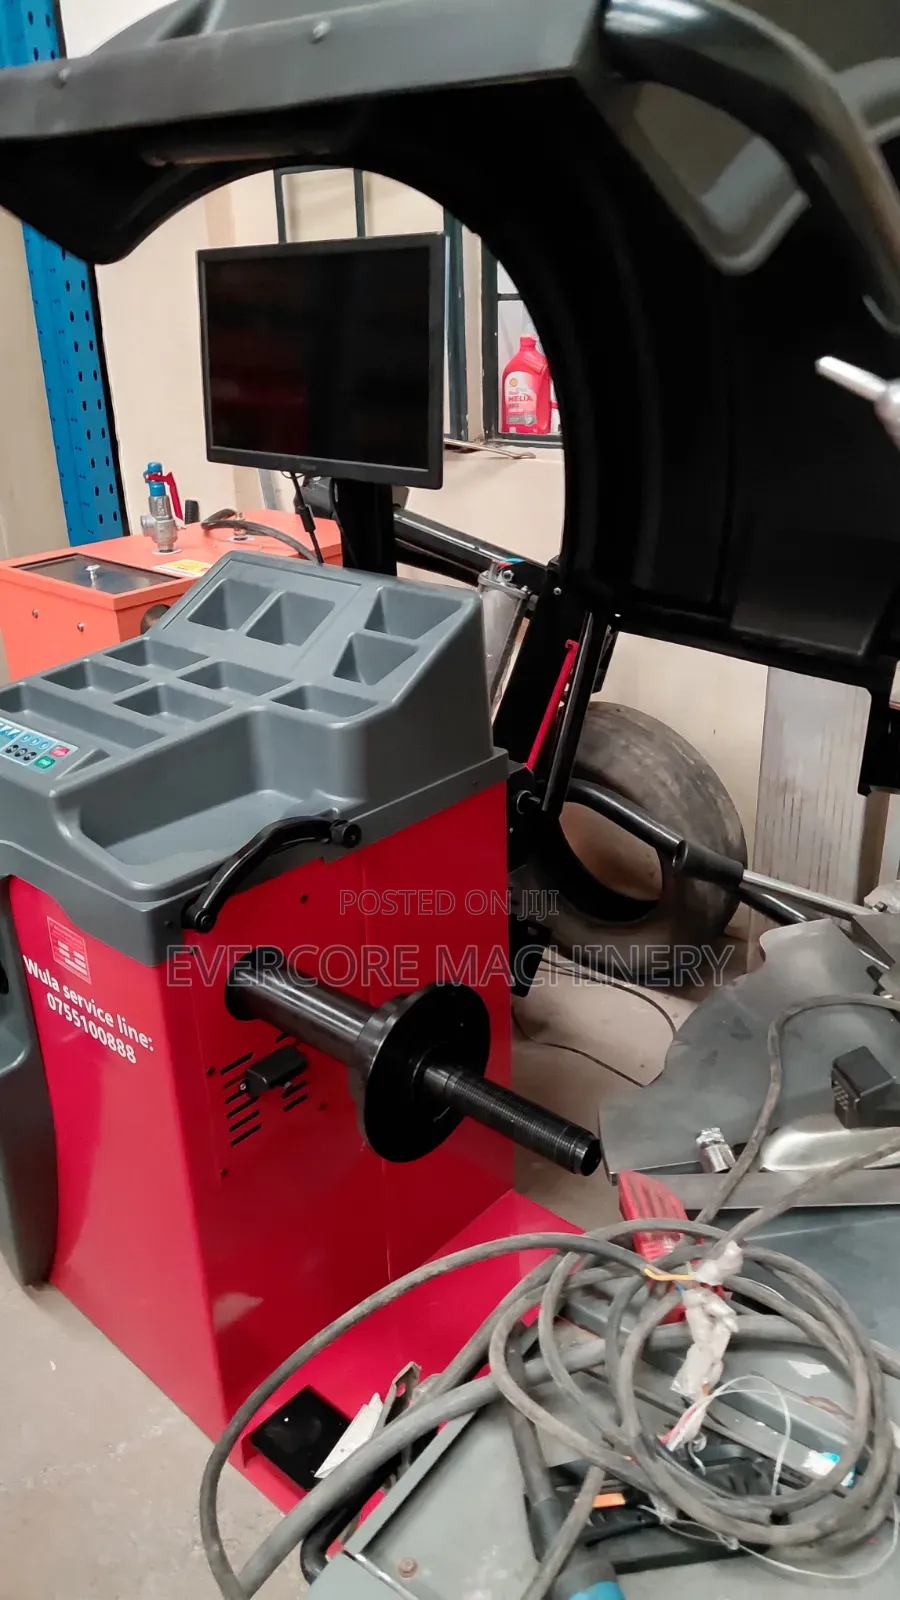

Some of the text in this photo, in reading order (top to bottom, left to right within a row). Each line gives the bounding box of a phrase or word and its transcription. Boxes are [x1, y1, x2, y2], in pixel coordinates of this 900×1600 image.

[22, 954, 155, 1052] Wula service line:
[46, 992, 137, 1064] 0755100888
